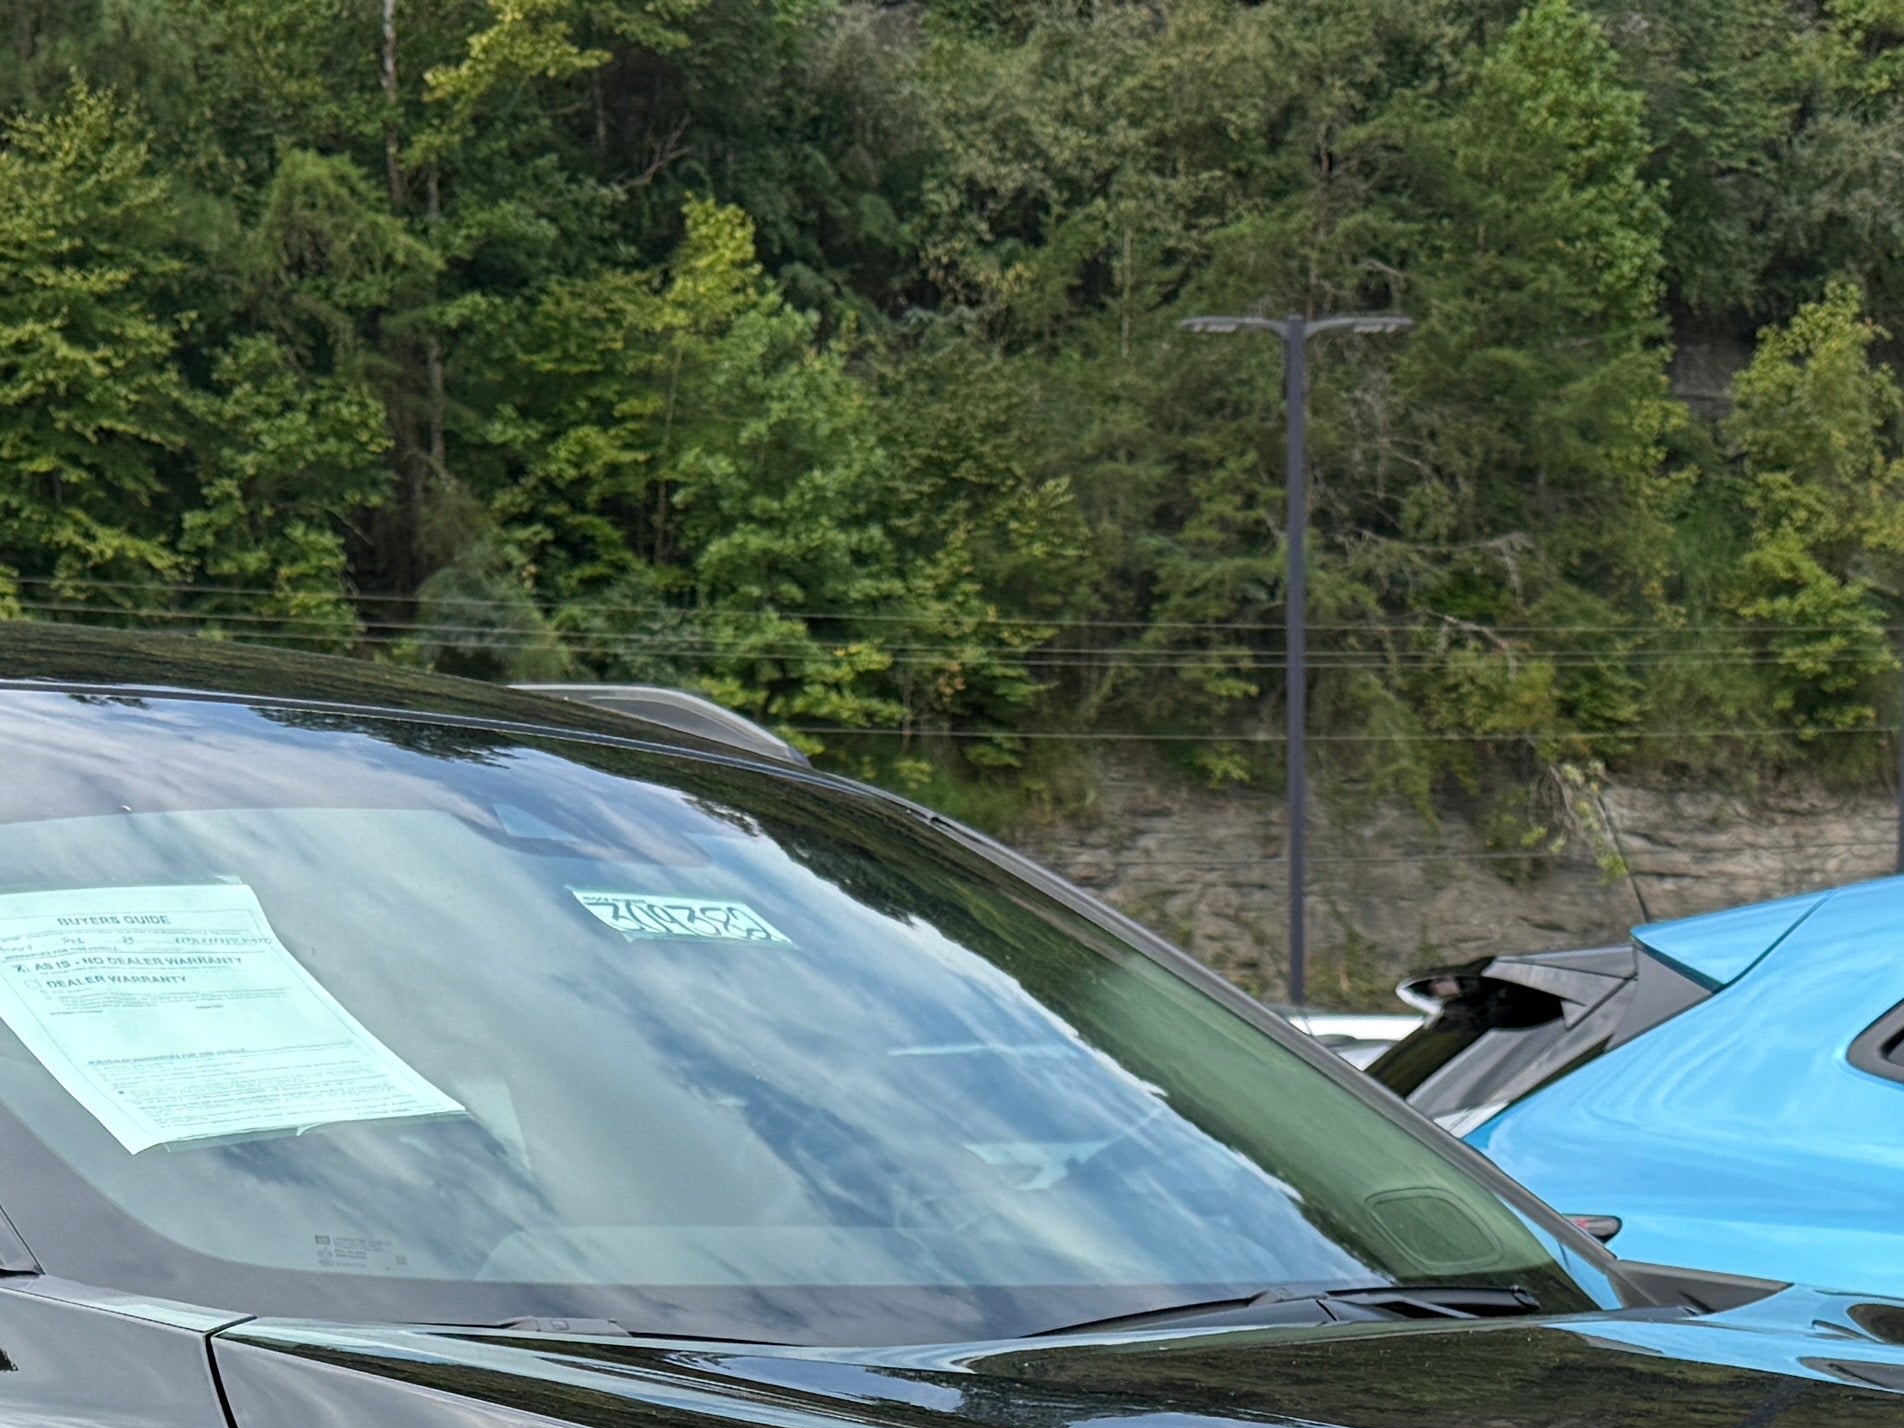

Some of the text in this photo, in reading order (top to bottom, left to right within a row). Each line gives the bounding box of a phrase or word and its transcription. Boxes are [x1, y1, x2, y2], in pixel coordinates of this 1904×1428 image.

[56, 914, 172, 927] BUYERS GUIDE
[34, 962, 53, 971] AS
[55, 959, 72, 969] IS
[82, 956, 105, 966] NO
[107, 955, 162, 967] DEALER
[163, 955, 244, 966] WARRANTY
[45, 974, 188, 989] DEALER WARRANTY
